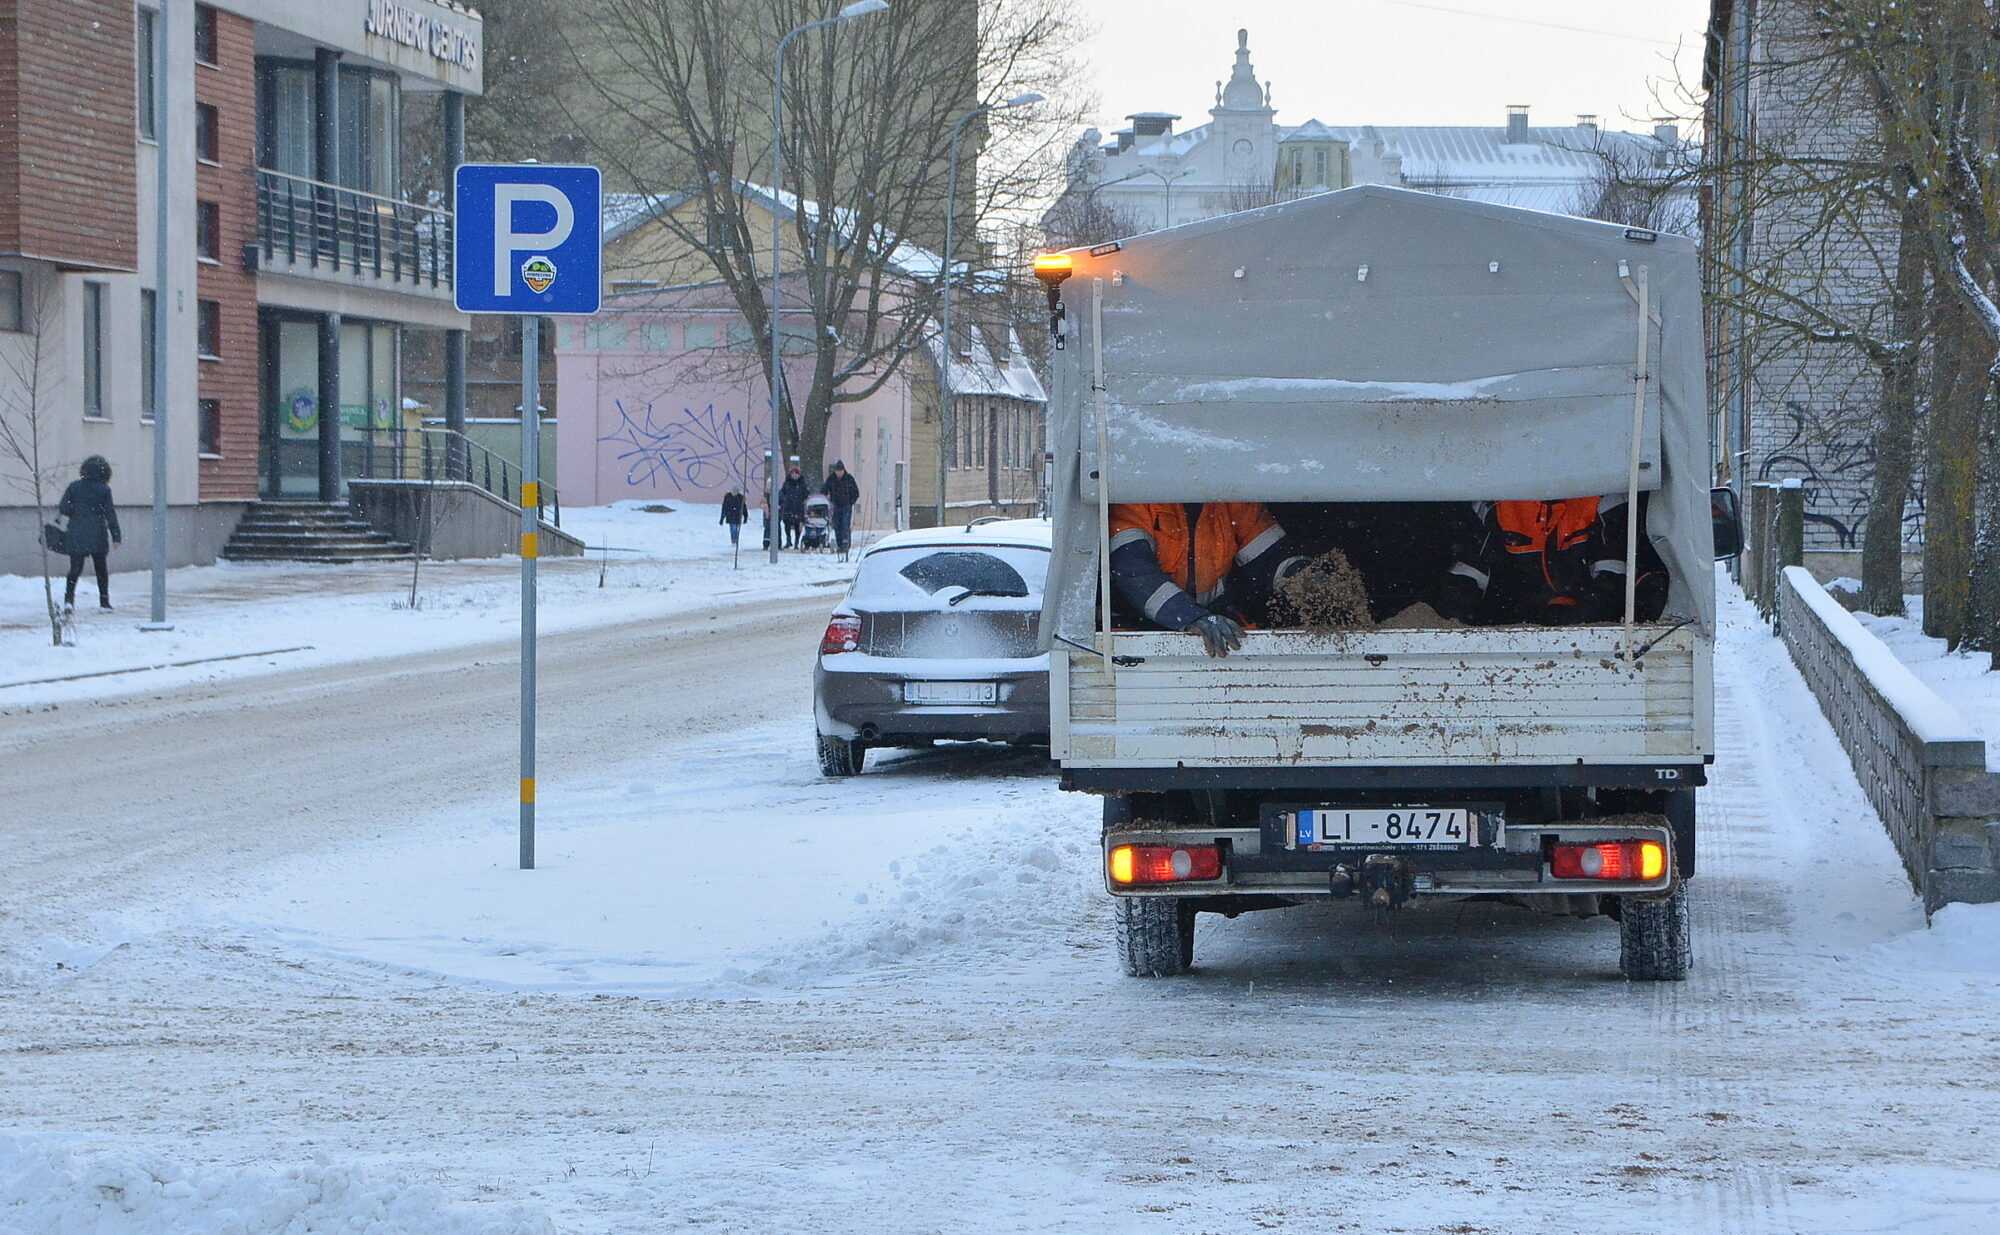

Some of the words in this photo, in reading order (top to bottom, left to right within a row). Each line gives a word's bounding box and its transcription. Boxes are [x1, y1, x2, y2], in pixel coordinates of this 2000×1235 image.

[431, 19, 477, 72] CENTRS
[494, 183, 575, 297] P
[1299, 829, 1312, 838] LV
[1321, 813, 1350, 840] LI
